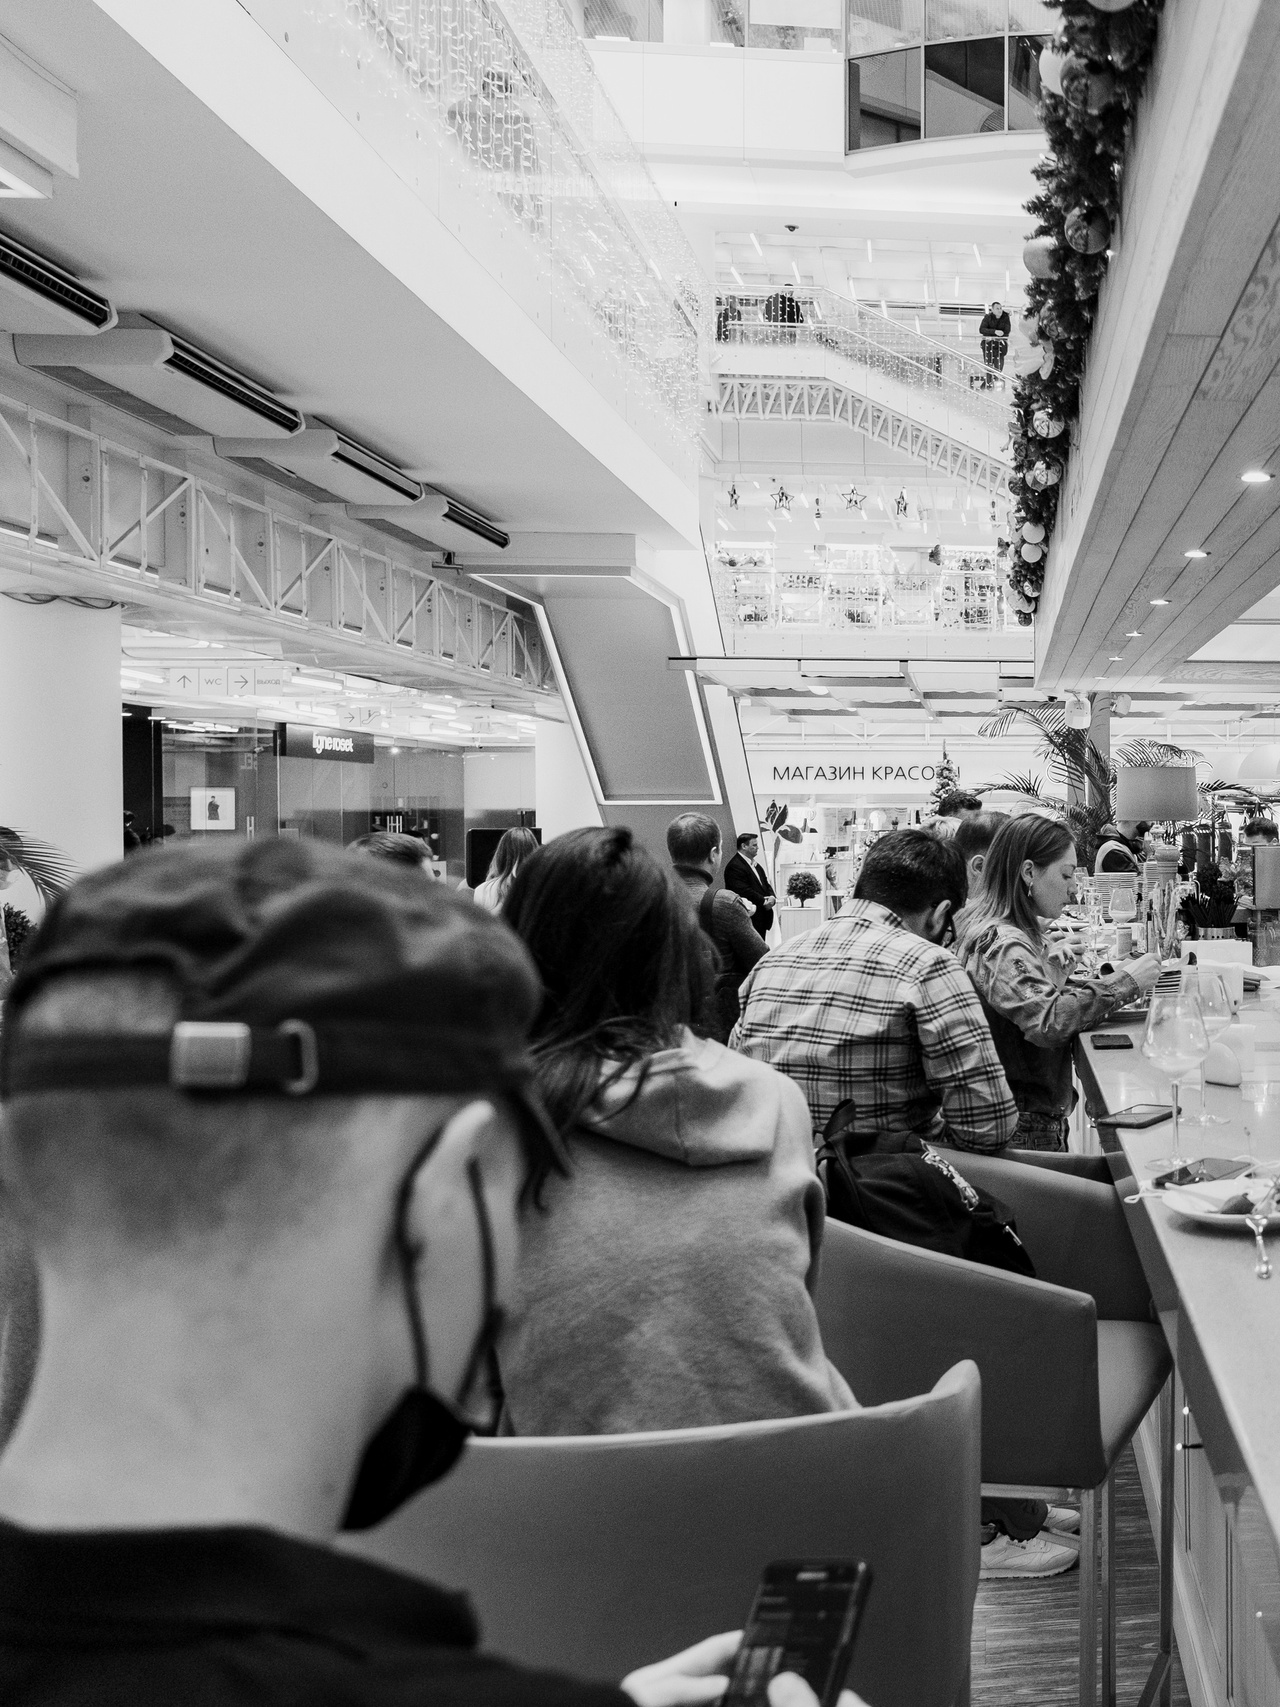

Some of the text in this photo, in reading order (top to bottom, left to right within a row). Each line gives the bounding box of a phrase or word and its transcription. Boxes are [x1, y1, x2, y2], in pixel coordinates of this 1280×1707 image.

[204, 678, 222, 686] WC
[332, 736, 354, 753] roset
[772, 765, 961, 781] МАГАЗИН КРАСО
